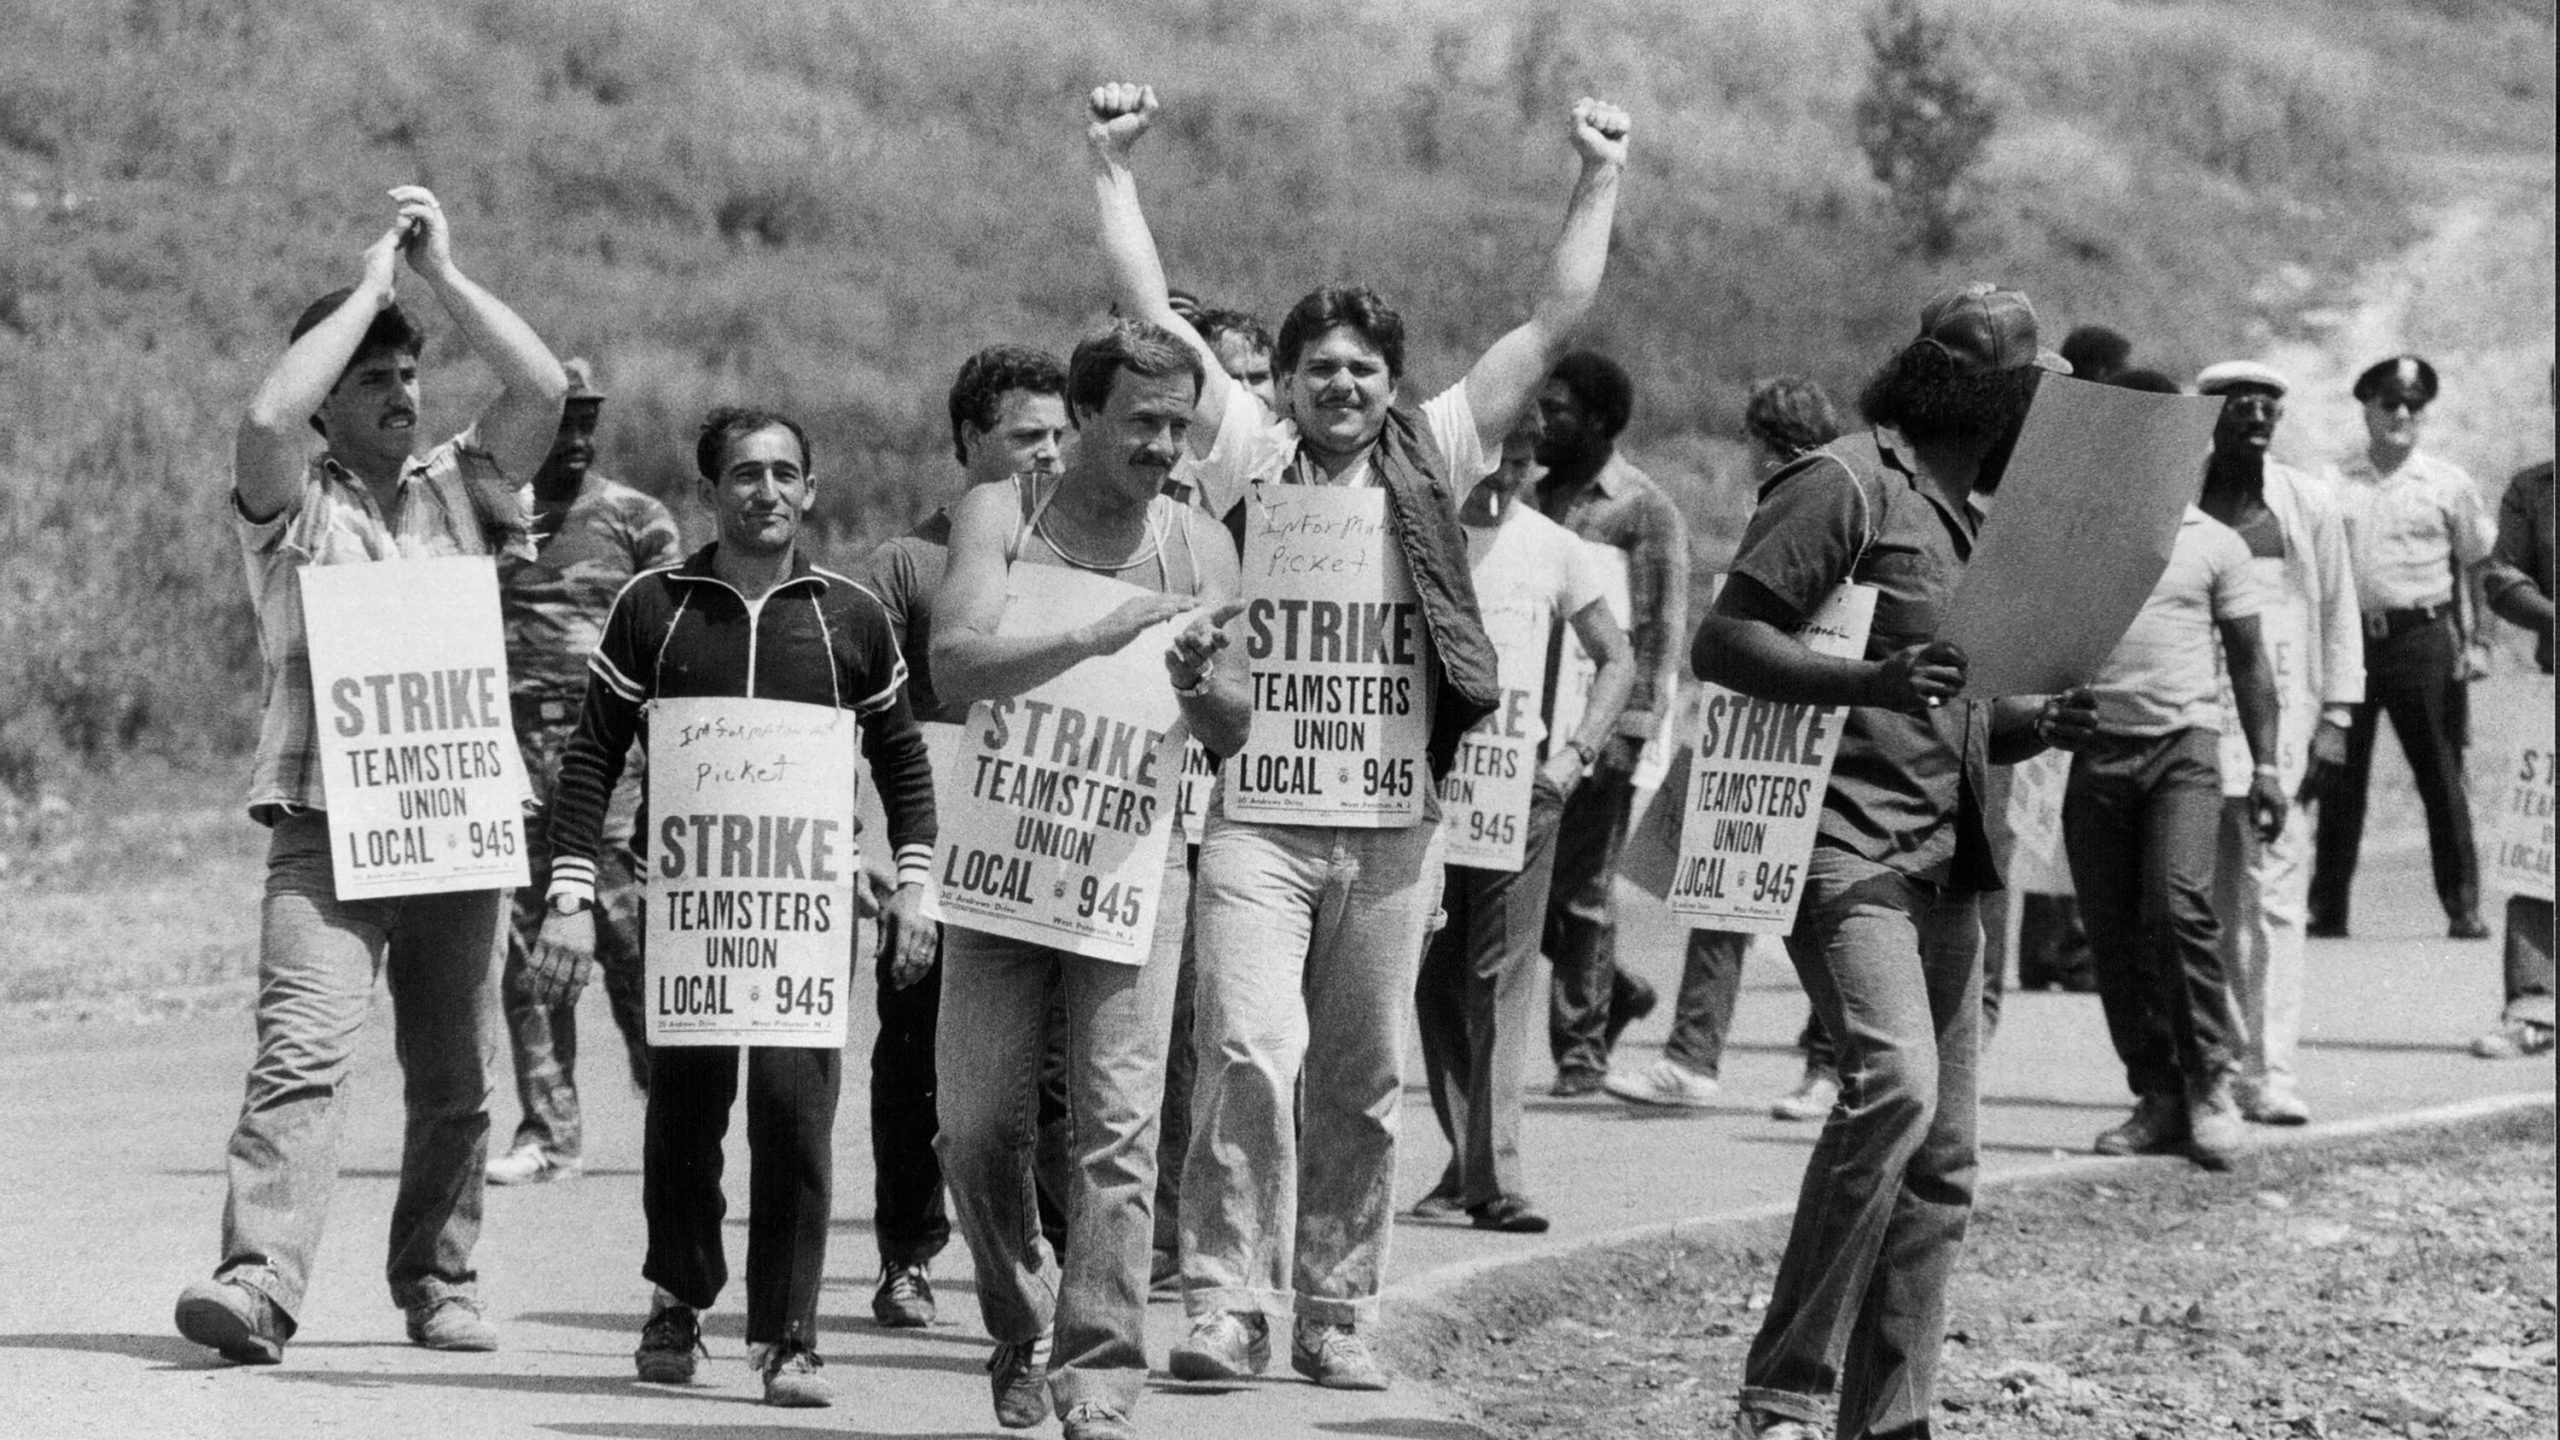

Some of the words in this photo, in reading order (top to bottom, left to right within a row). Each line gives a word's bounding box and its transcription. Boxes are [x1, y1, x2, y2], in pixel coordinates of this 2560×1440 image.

[1246, 598, 1417, 666] STRIKE
[331, 667, 501, 738] STRIKE
[1251, 671, 1411, 716] TEAMSTERS
[983, 697, 1166, 789] STRIKE
[1293, 718, 1365, 752] UNION
[1702, 694, 1838, 767] STRIKE
[347, 740, 502, 788] TEAMSTERS
[1239, 753, 1323, 796] LOCAL
[1363, 758, 1414, 798] 945
[399, 786, 468, 821] UNION
[974, 754, 1157, 837] TEAMSTERS
[1442, 778, 1475, 805] ION
[1697, 770, 1811, 819] TEAMSTERS
[349, 826, 435, 869] LOCAL
[469, 820, 516, 859] 945
[660, 814, 840, 882] STRIKE
[1015, 815, 1096, 866] UNION
[1470, 810, 1517, 845] 945
[1713, 818, 1767, 855] UNION
[942, 844, 1034, 904] LOCAL
[1078, 875, 1144, 928] 945
[1675, 855, 1727, 899] LOCAL
[1753, 861, 1799, 904] 945
[667, 890, 831, 933] TEAMSTERS
[706, 936, 778, 969] UNION
[659, 975, 734, 1016] LOCAL
[775, 975, 835, 1016] 945
